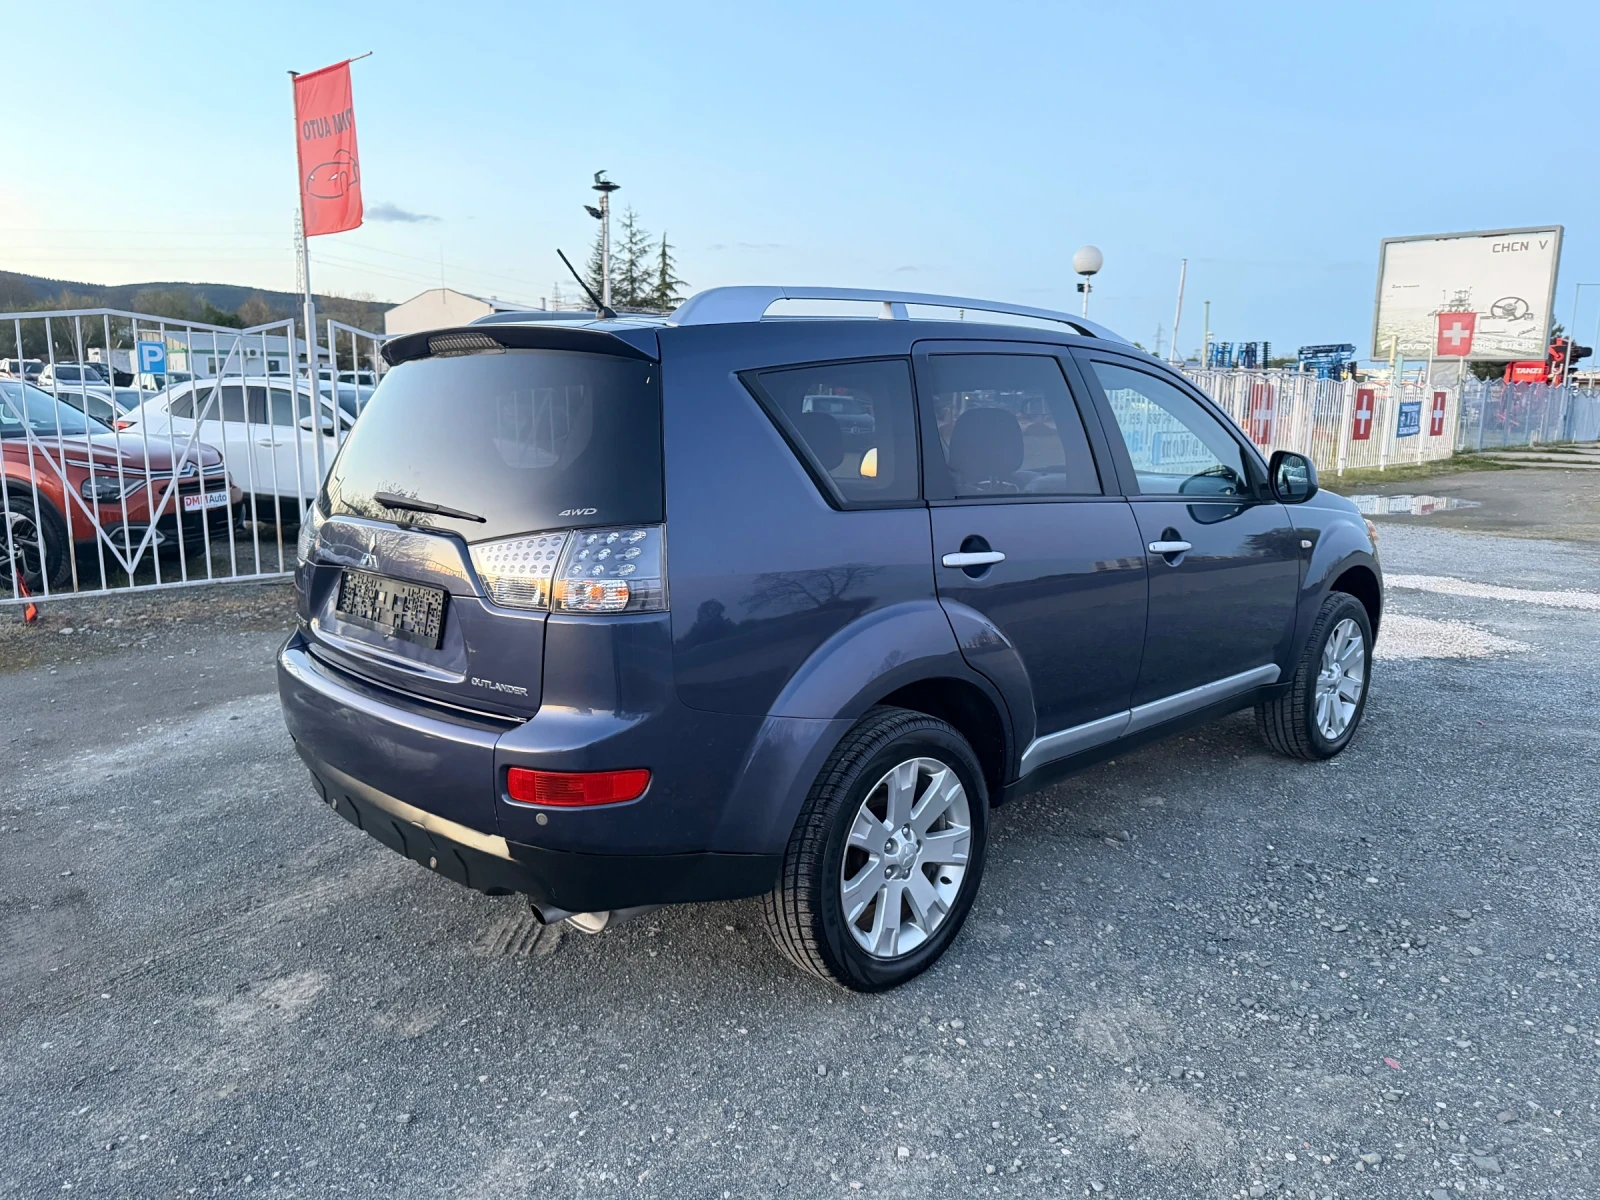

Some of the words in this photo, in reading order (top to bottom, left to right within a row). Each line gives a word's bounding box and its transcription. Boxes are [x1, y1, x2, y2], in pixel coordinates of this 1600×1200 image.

[142, 345, 164, 370] P
[559, 508, 598, 516] 4WD
[471, 677, 528, 696] OUTLANDER
